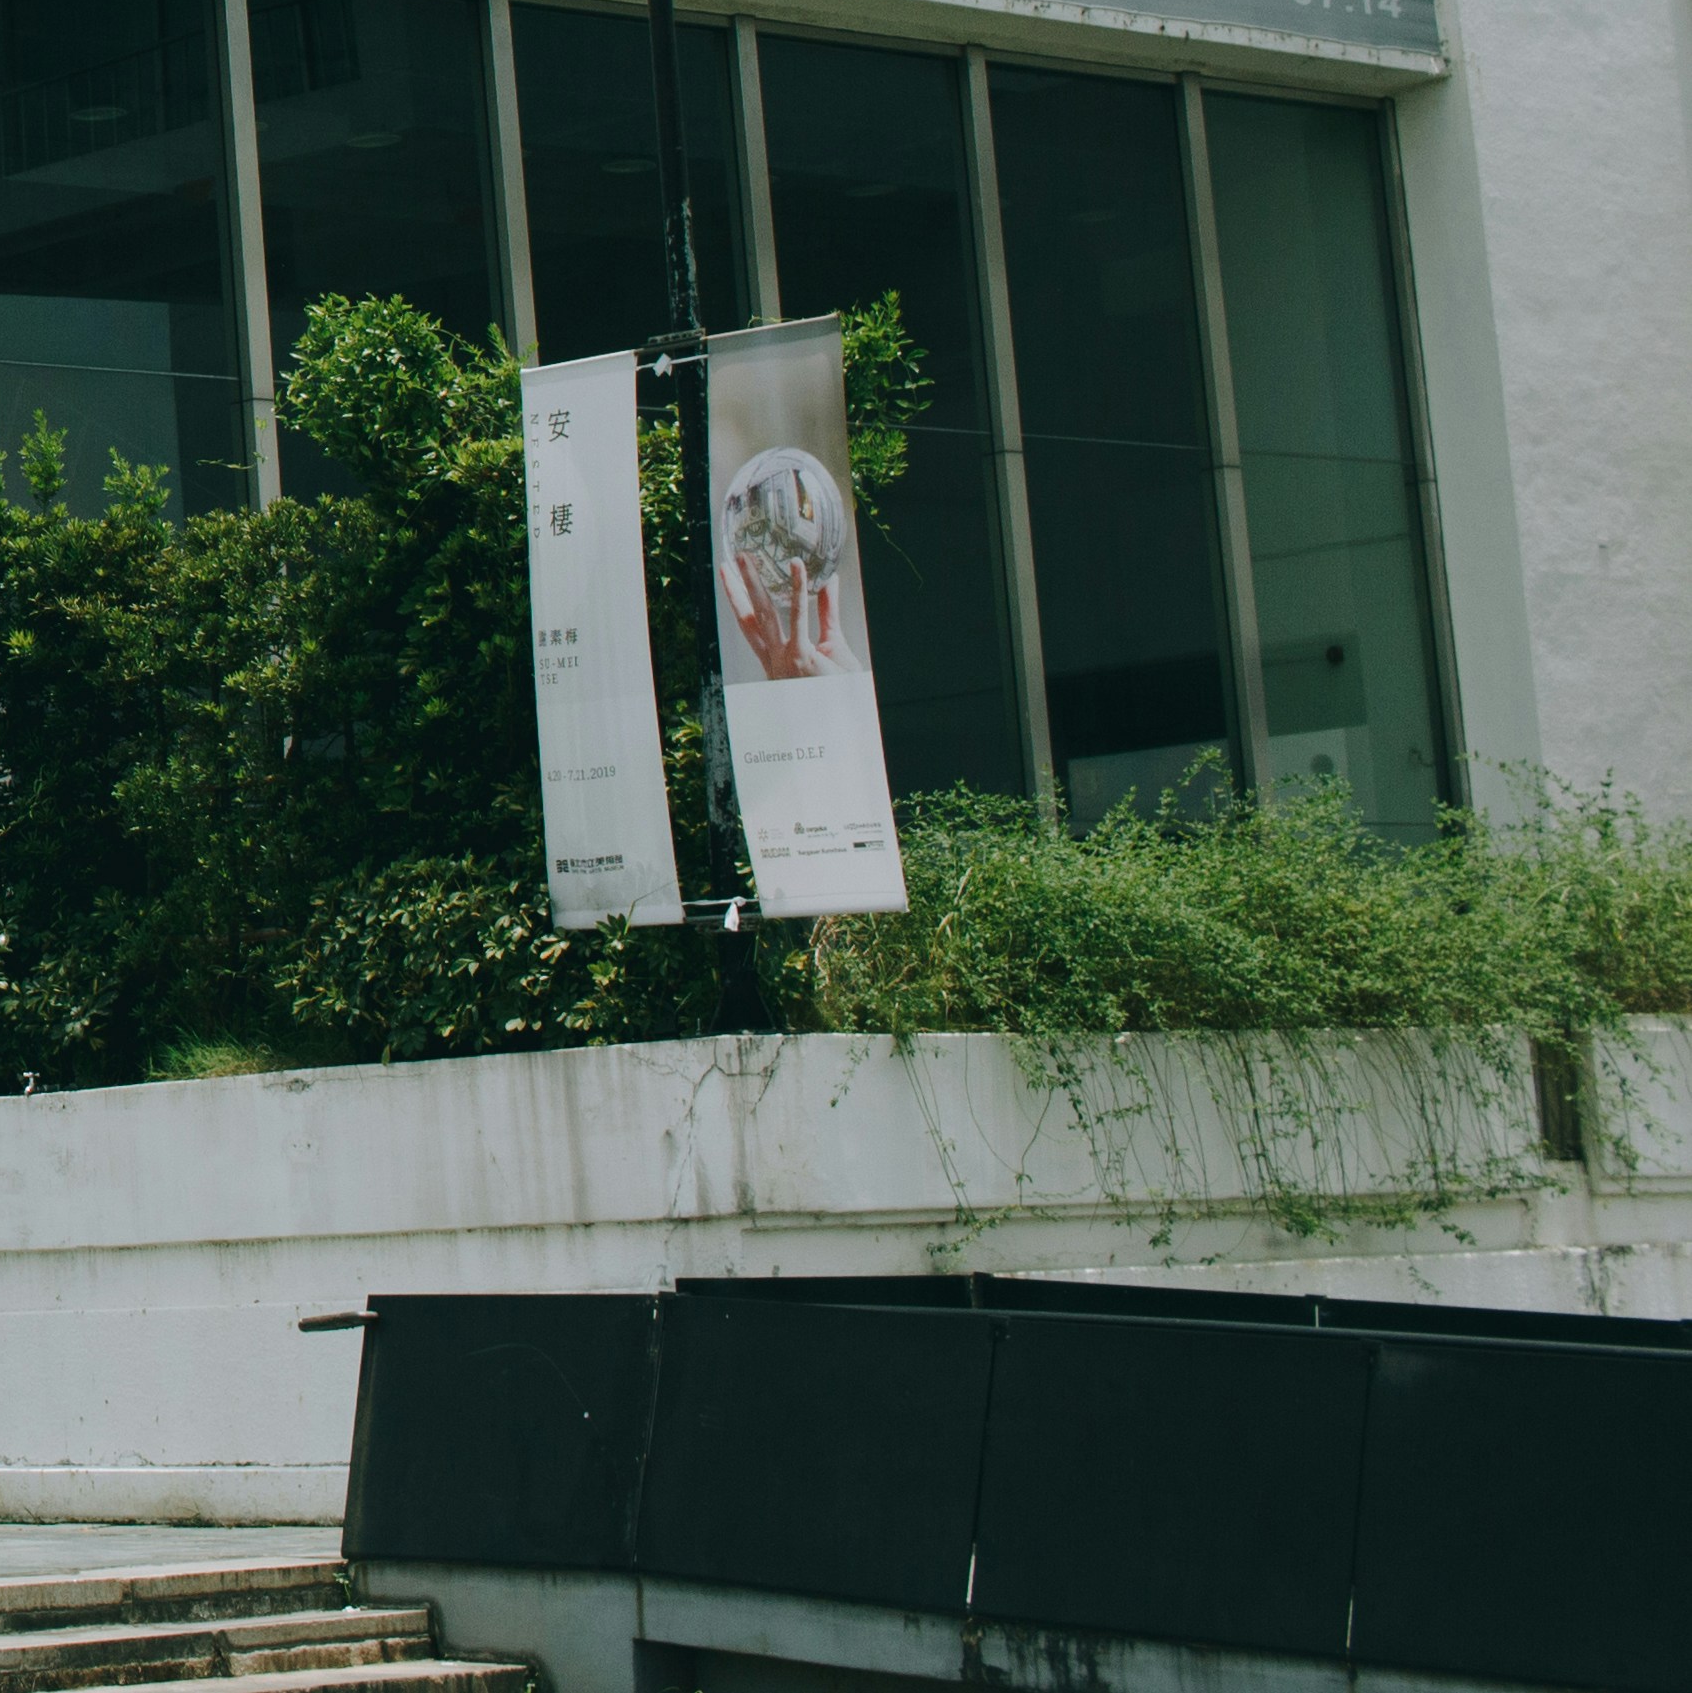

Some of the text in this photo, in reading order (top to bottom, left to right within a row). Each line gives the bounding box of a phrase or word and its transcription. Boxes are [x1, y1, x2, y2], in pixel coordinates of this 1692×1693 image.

[530, 412, 541, 539] NESTED
[538, 655, 580, 671] SU-MEI
[540, 673, 559, 685] TSE
[743, 745, 826, 764] Galleries D.E.F
[567, 765, 617, 782] 7.21.2019
